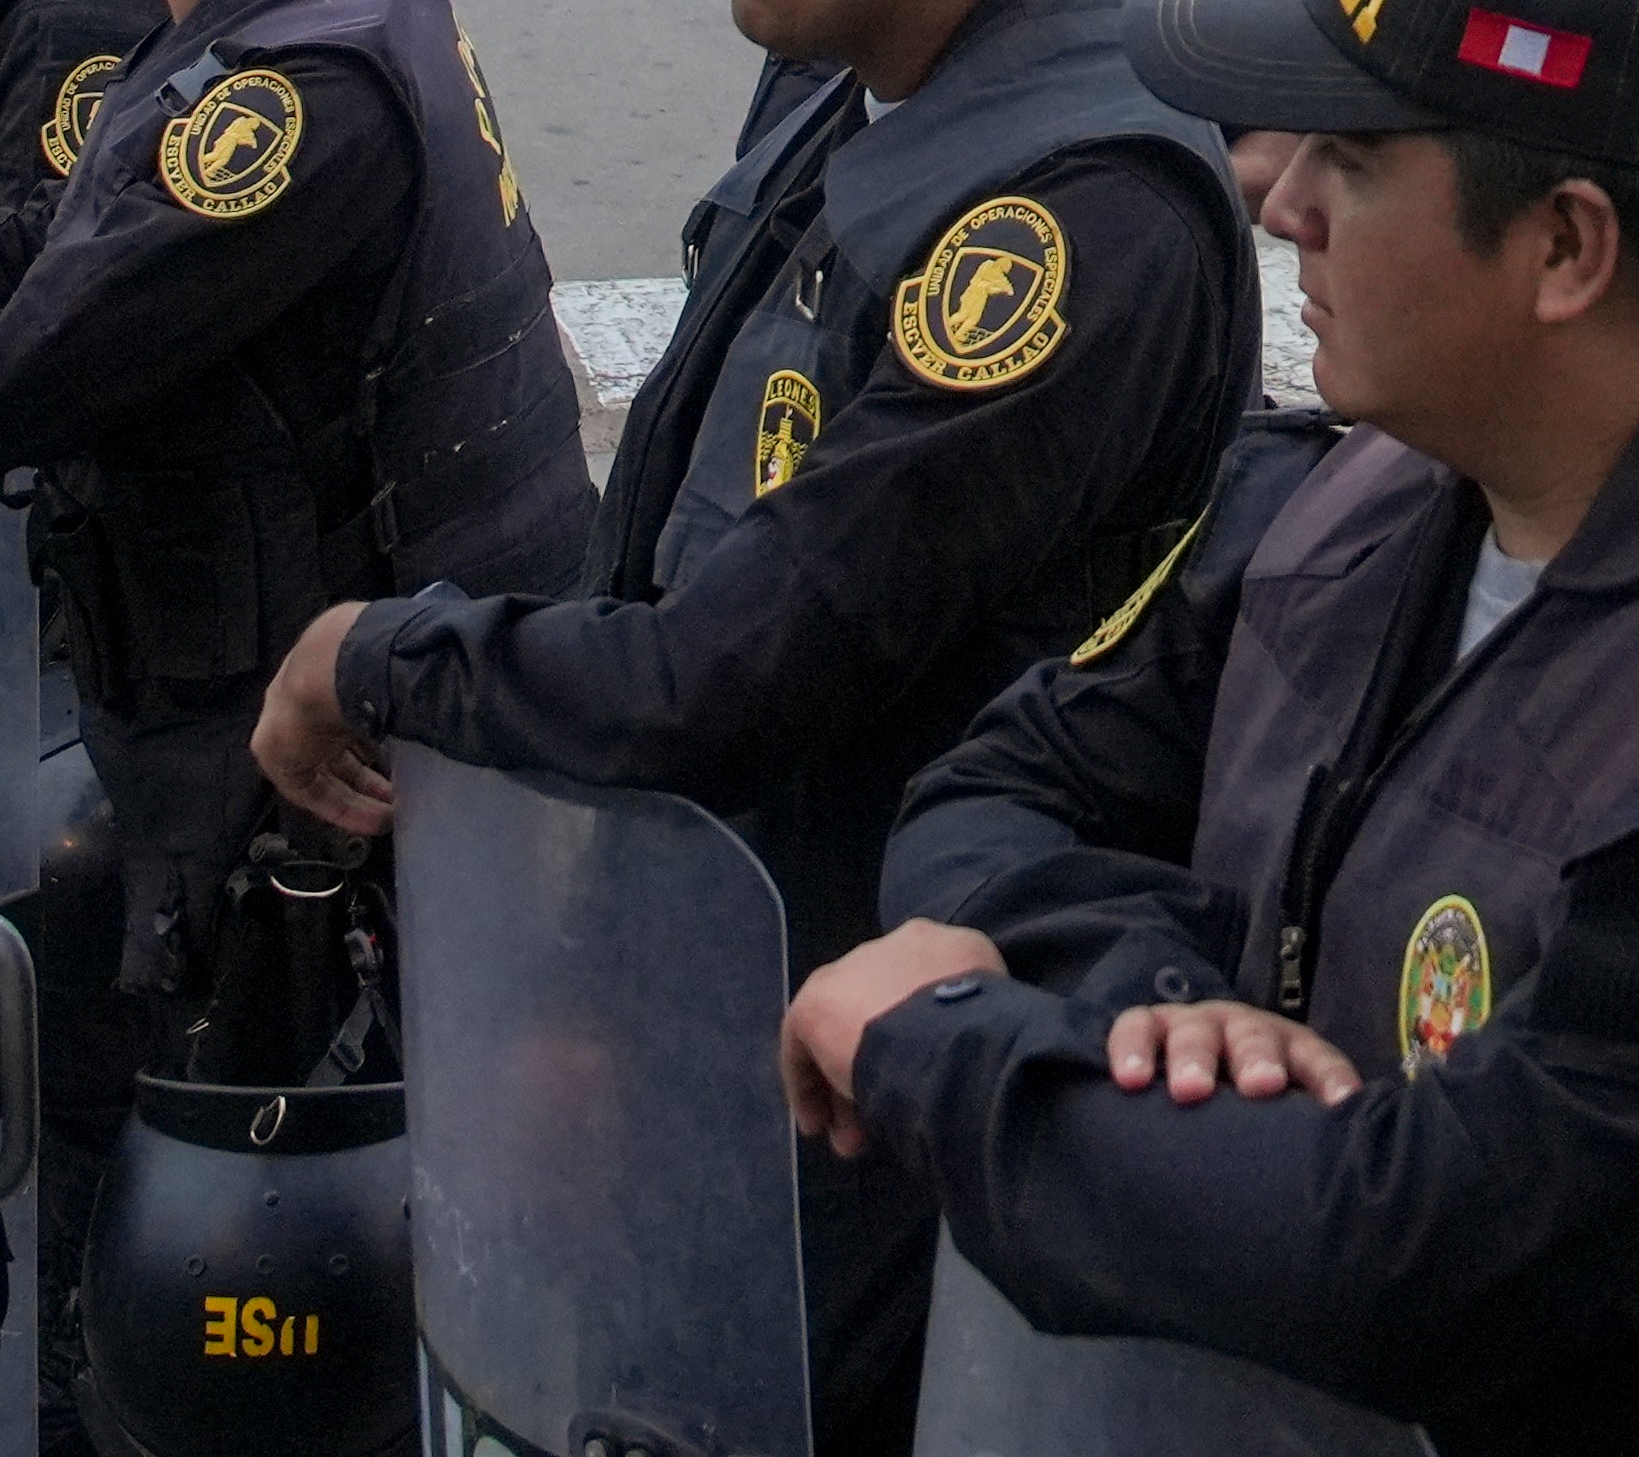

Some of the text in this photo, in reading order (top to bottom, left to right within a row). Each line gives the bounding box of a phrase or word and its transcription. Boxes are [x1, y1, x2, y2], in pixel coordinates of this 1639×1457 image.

[190, 101, 217, 136] UNIDAD
[217, 87, 231, 101] DE
[233, 76, 294, 113] OPERACIONES
[202, 181, 277, 212] CALLAO
[927, 206, 1059, 322] UNIDAD DE OPERACIONES ESPECIALES
[903, 301, 1050, 381] ESCVER CALLAO
[769, 379, 816, 415] LEONES
